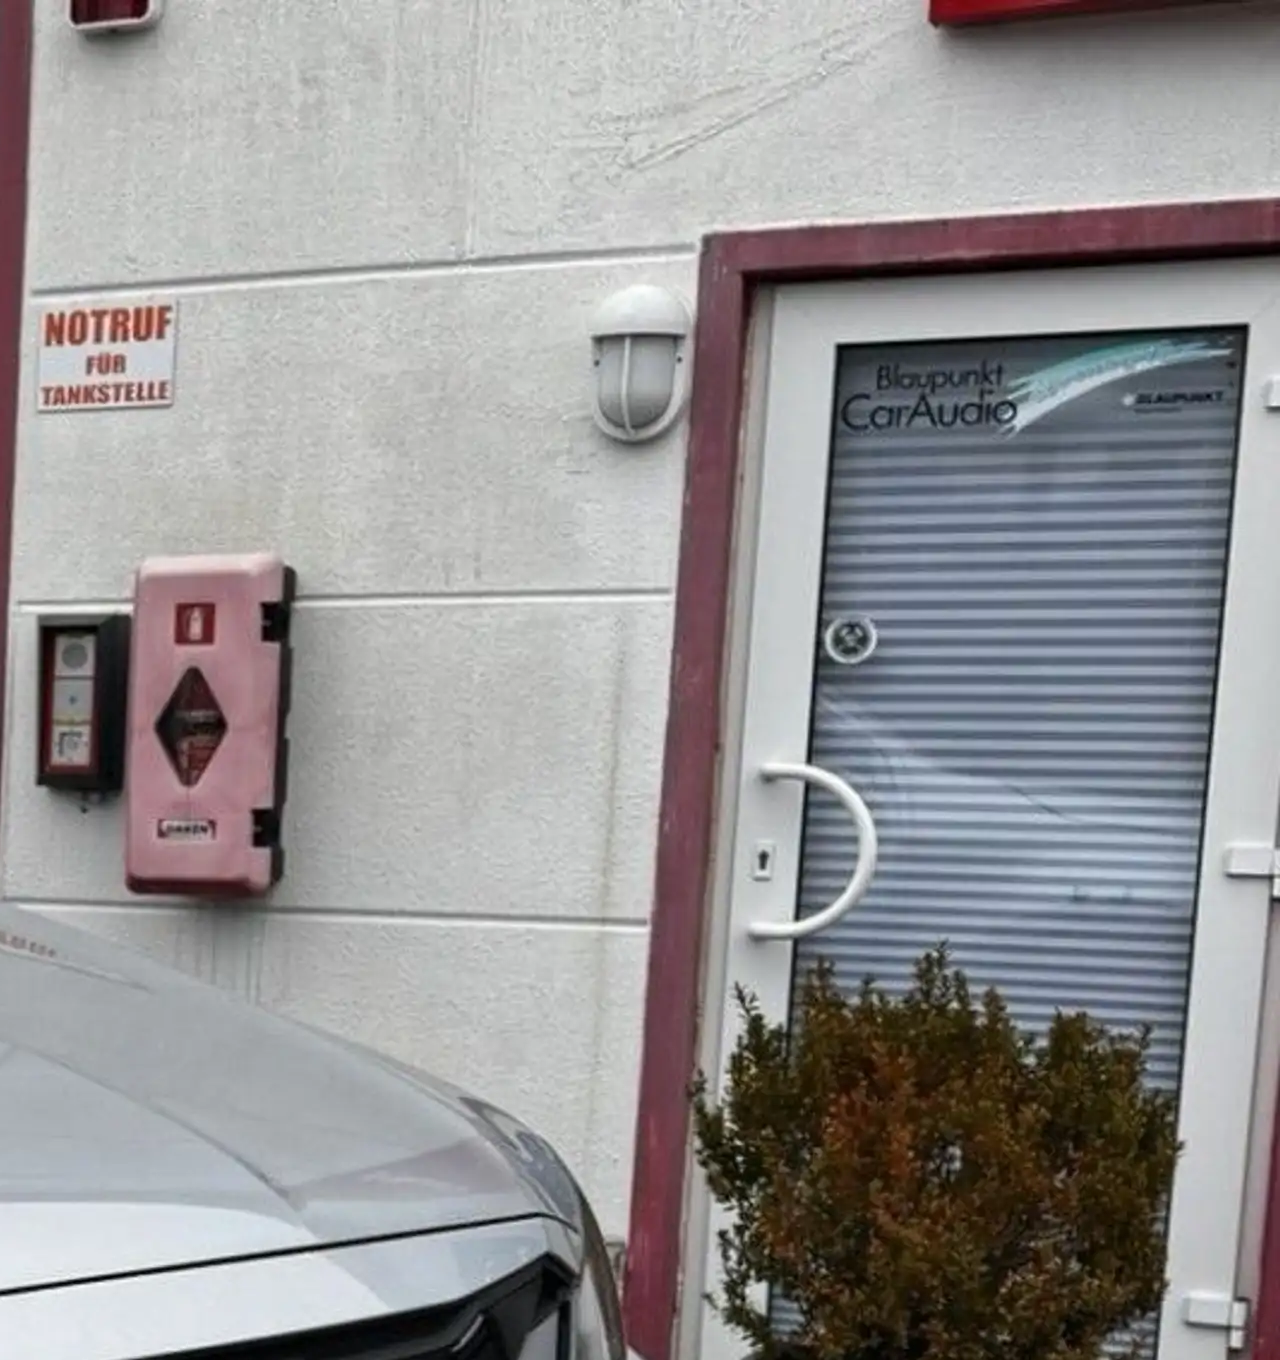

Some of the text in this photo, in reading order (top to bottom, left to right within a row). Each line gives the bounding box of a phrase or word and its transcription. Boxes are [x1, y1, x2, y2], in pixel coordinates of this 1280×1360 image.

[44, 304, 173, 347] NOTRUF
[85, 352, 127, 376] FÜR
[876, 358, 1003, 394] Blaupunkt
[40, 380, 170, 406] TANKSTELLE
[840, 387, 1018, 431] CarAudio
